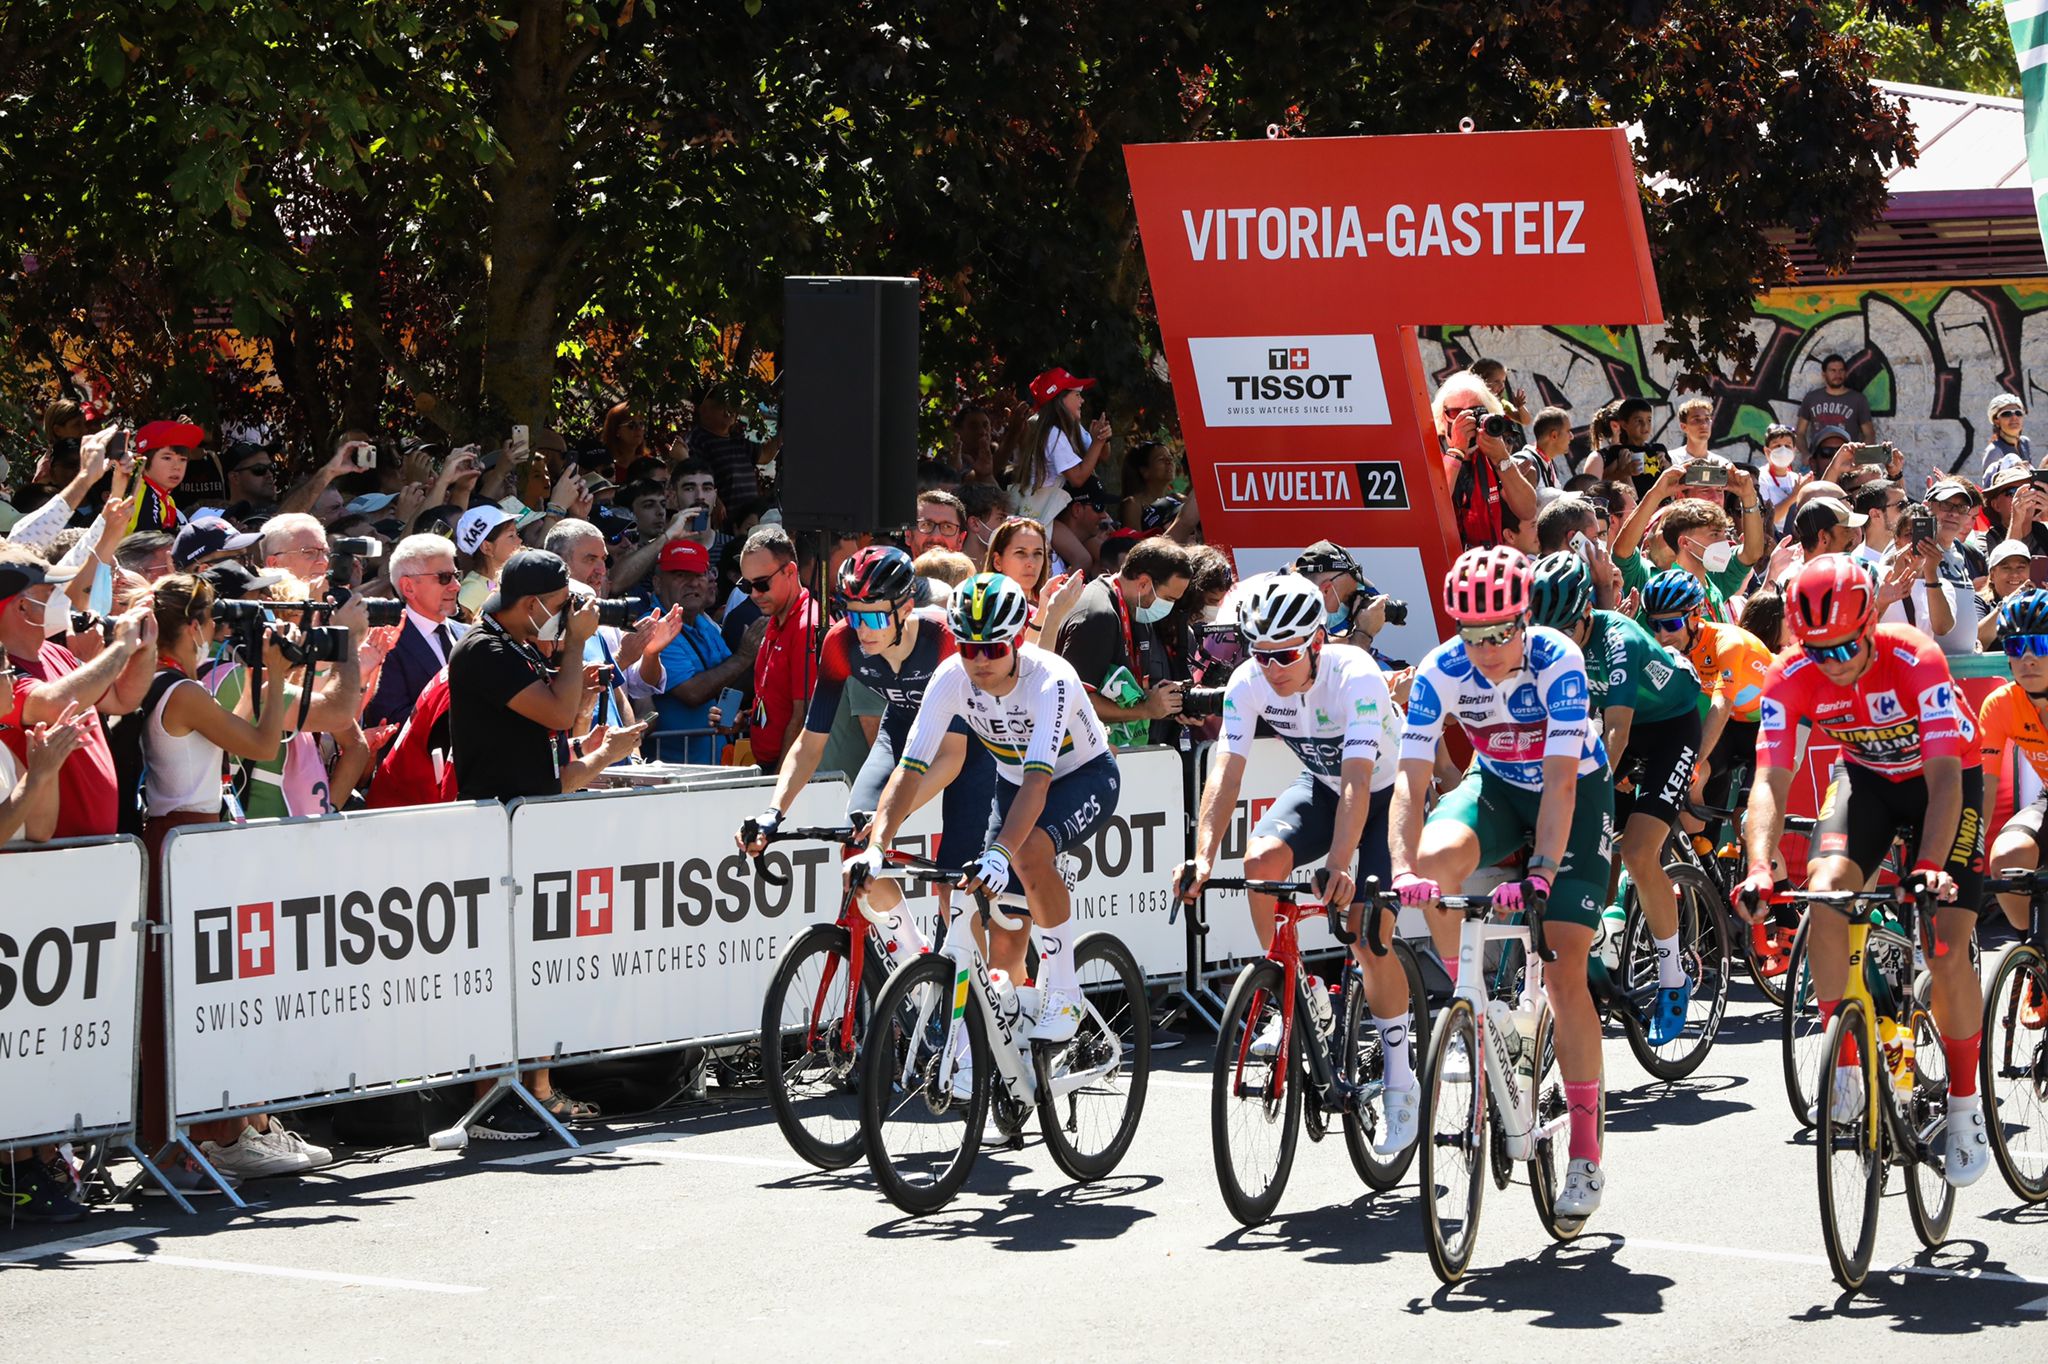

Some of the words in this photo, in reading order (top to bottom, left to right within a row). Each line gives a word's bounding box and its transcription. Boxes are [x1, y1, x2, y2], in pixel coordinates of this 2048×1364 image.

[1182, 200, 1586, 261] VITORIA-GASTEIZ
[1227, 374, 1353, 401] TISSOT
[1227, 407, 1255, 415] SWISS
[1259, 406, 1300, 414] WATCHES
[1304, 405, 1330, 414] SINCE
[1334, 405, 1353, 413] 1853
[1811, 402, 1853, 419] TORONTO
[1231, 472, 1260, 502] LA
[1262, 470, 1351, 501] VUELTA
[1367, 470, 1397, 500] 22
[463, 518, 488, 548] KAS
[1264, 705, 1298, 717] Santini
[1458, 694, 1494, 705] Santini
[1816, 700, 1853, 714] Santini
[1051, 679, 1065, 753] GRENADIER
[1659, 745, 1694, 805] KERN
[1063, 794, 1101, 841] INEOS
[1950, 807, 1979, 868] JUMBO
[620, 847, 830, 932] TISSOT
[1065, 871, 1077, 893] 85
[1077, 894, 1118, 920] INCE
[1129, 889, 1168, 914] 1853
[281, 877, 490, 972] TISSOT
[531, 955, 600, 986] SWISS
[612, 943, 707, 977] WATCHES
[719, 936, 777, 965] SINCE
[195, 998, 264, 1034] SWISS
[276, 983, 371, 1023] WATCHES
[382, 974, 442, 1007] SINCE
[453, 968, 494, 997] 1853
[61, 1019, 111, 1052] 1853
